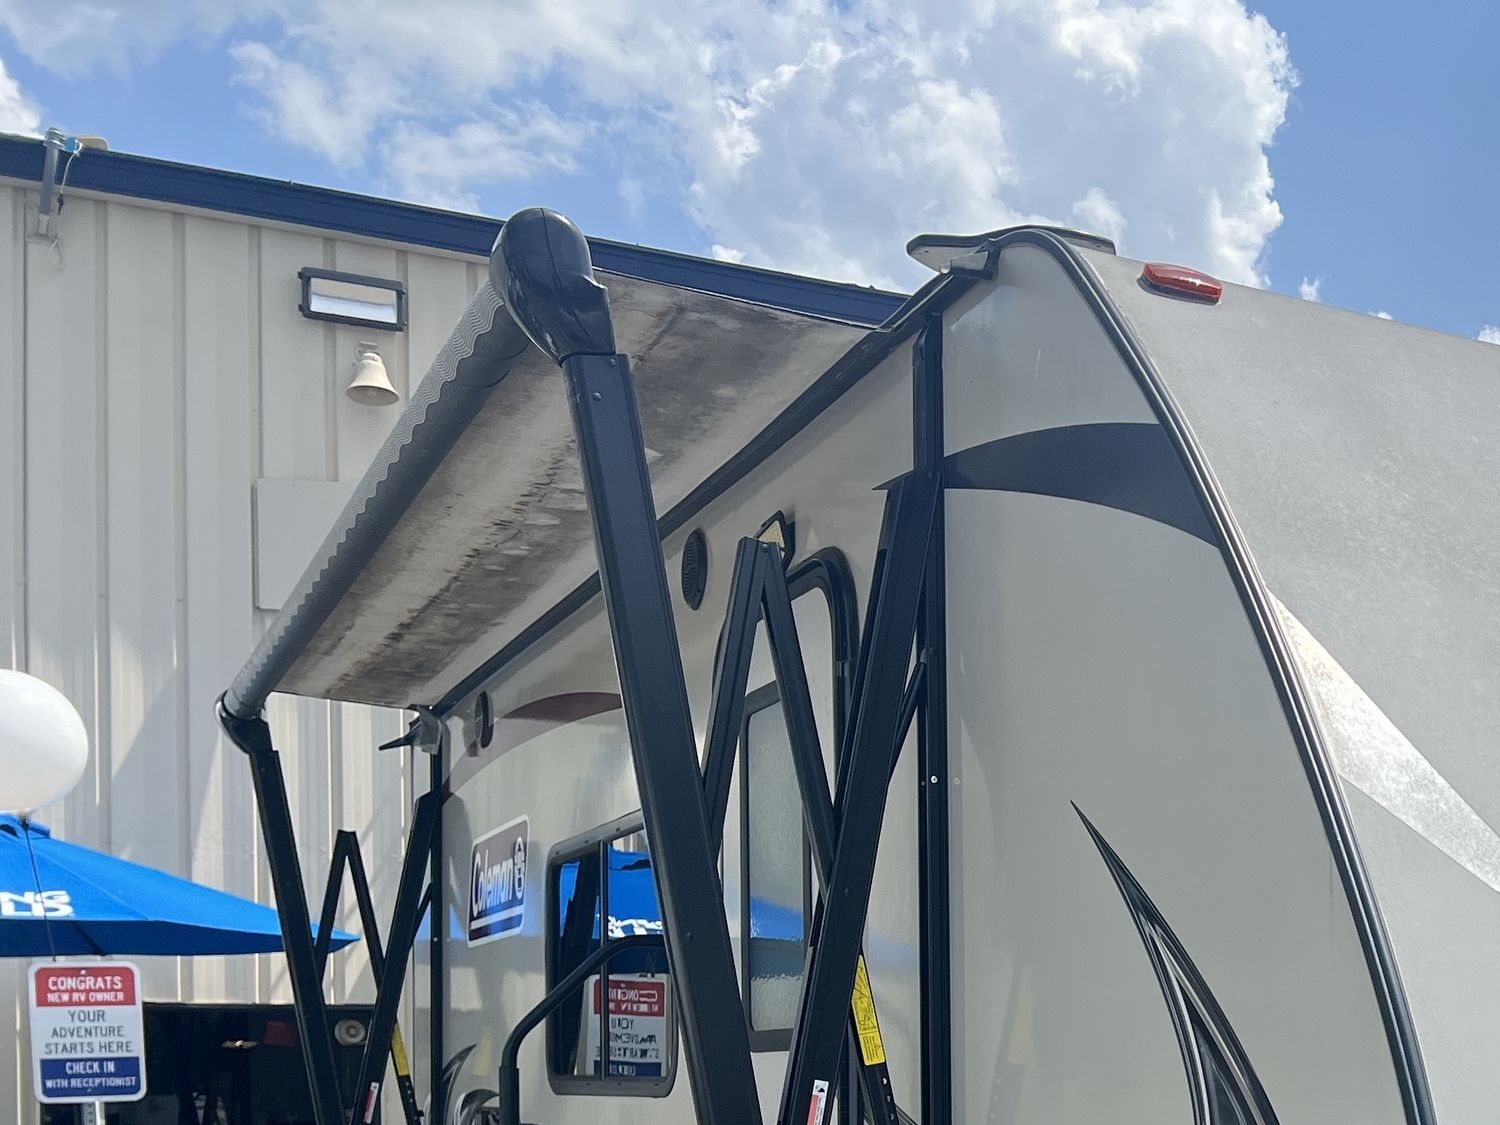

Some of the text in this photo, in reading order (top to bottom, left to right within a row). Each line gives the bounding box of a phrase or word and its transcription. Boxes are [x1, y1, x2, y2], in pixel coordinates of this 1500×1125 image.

[472, 848, 514, 918] Coleman
[47, 975, 122, 991] CONGRATS
[46, 991, 125, 1003] NEW RV OWNER
[67, 1009, 106, 1023] YOUR
[50, 1025, 125, 1039] ADVENTURE
[44, 1040, 134, 1055] STARTS HERE
[65, 1060, 115, 1075] CHECK IN
[45, 1076, 137, 1089] WITH RECEPTIONIST
